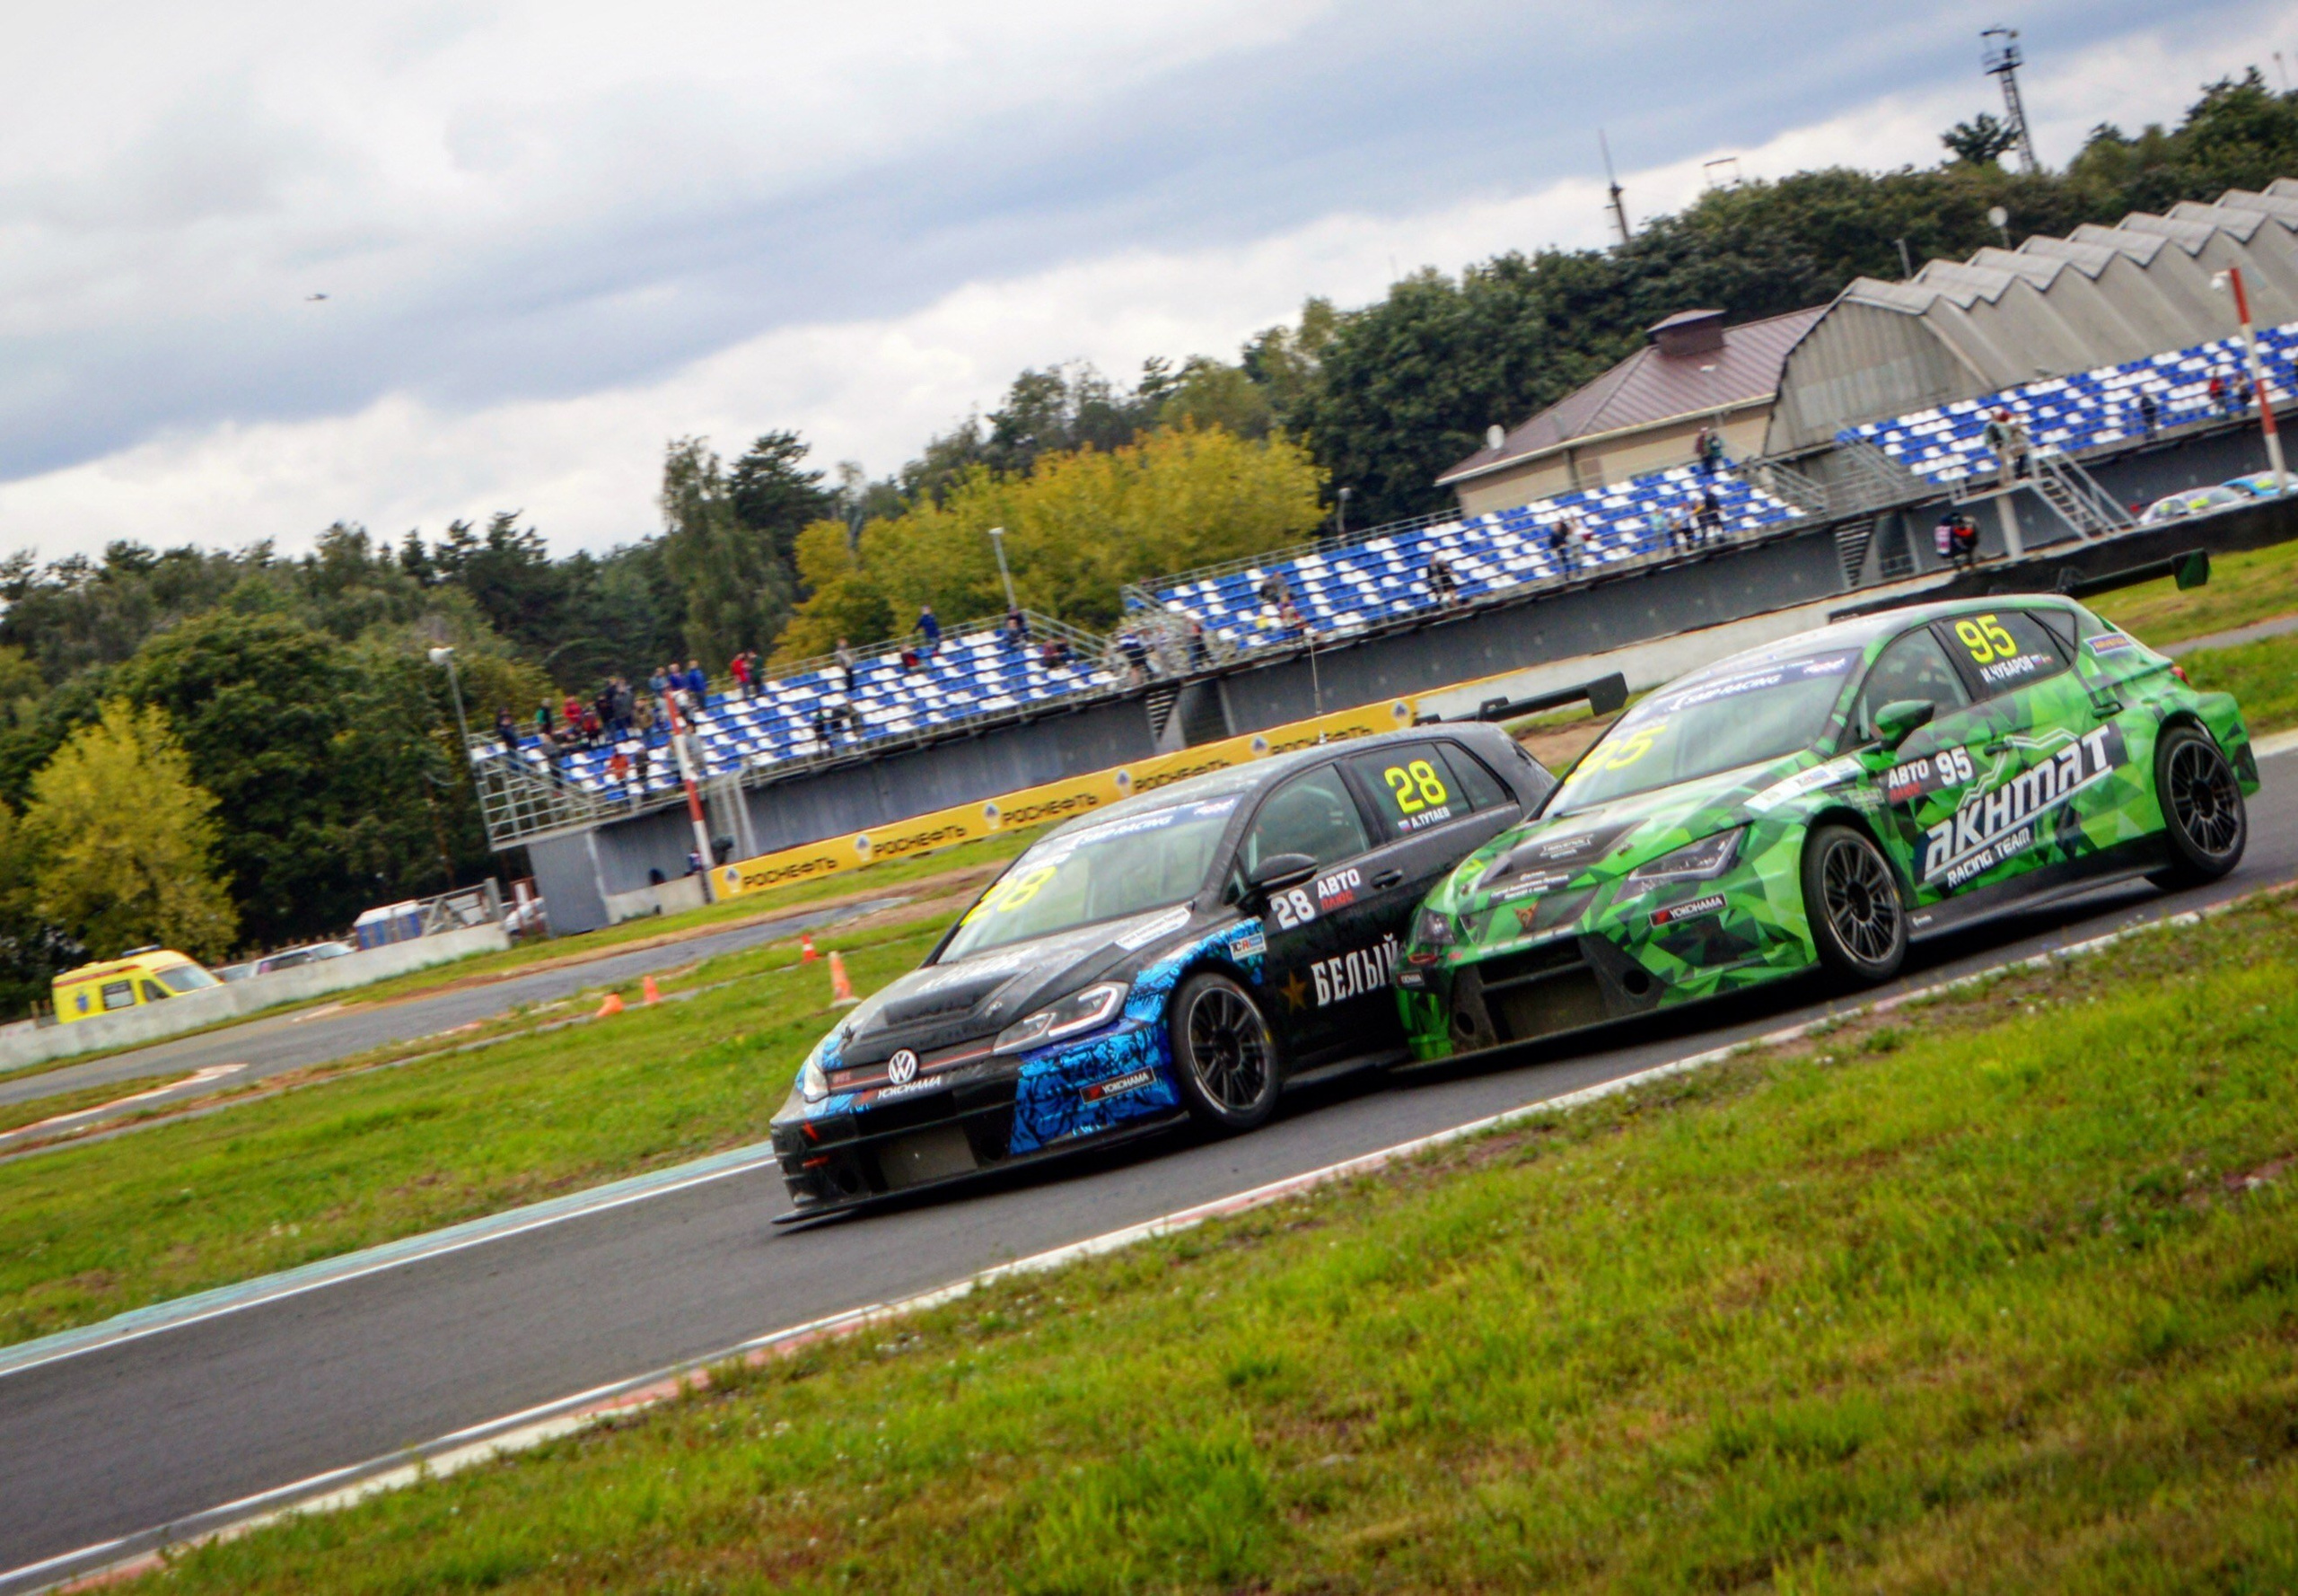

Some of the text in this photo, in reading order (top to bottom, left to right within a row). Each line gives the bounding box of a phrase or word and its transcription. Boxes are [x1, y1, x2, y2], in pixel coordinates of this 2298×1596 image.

[1955, 614, 2017, 663] 95
[1563, 724, 1668, 785] 95
[1935, 746, 1973, 787] 95
[1384, 760, 1447, 813] 28
[1888, 759, 1929, 788] АВТО
[1003, 793, 1099, 825] РОСНЕФТЬ
[873, 825, 967, 856] РОСНЕФТЬ
[1946, 827, 2030, 889] RACING TEAM
[743, 856, 838, 888] РОСНЕФТЬ
[1317, 868, 1361, 899] АВТО
[960, 866, 1057, 926] 28
[1271, 889, 1316, 930] 28
[1670, 896, 1724, 918] YOKOHAMA
[1311, 932, 1399, 1006] БЕЛЫЙ
[877, 1075, 941, 1100] YOKOHAMA
[1101, 1072, 1149, 1093] YOKOHAMA
